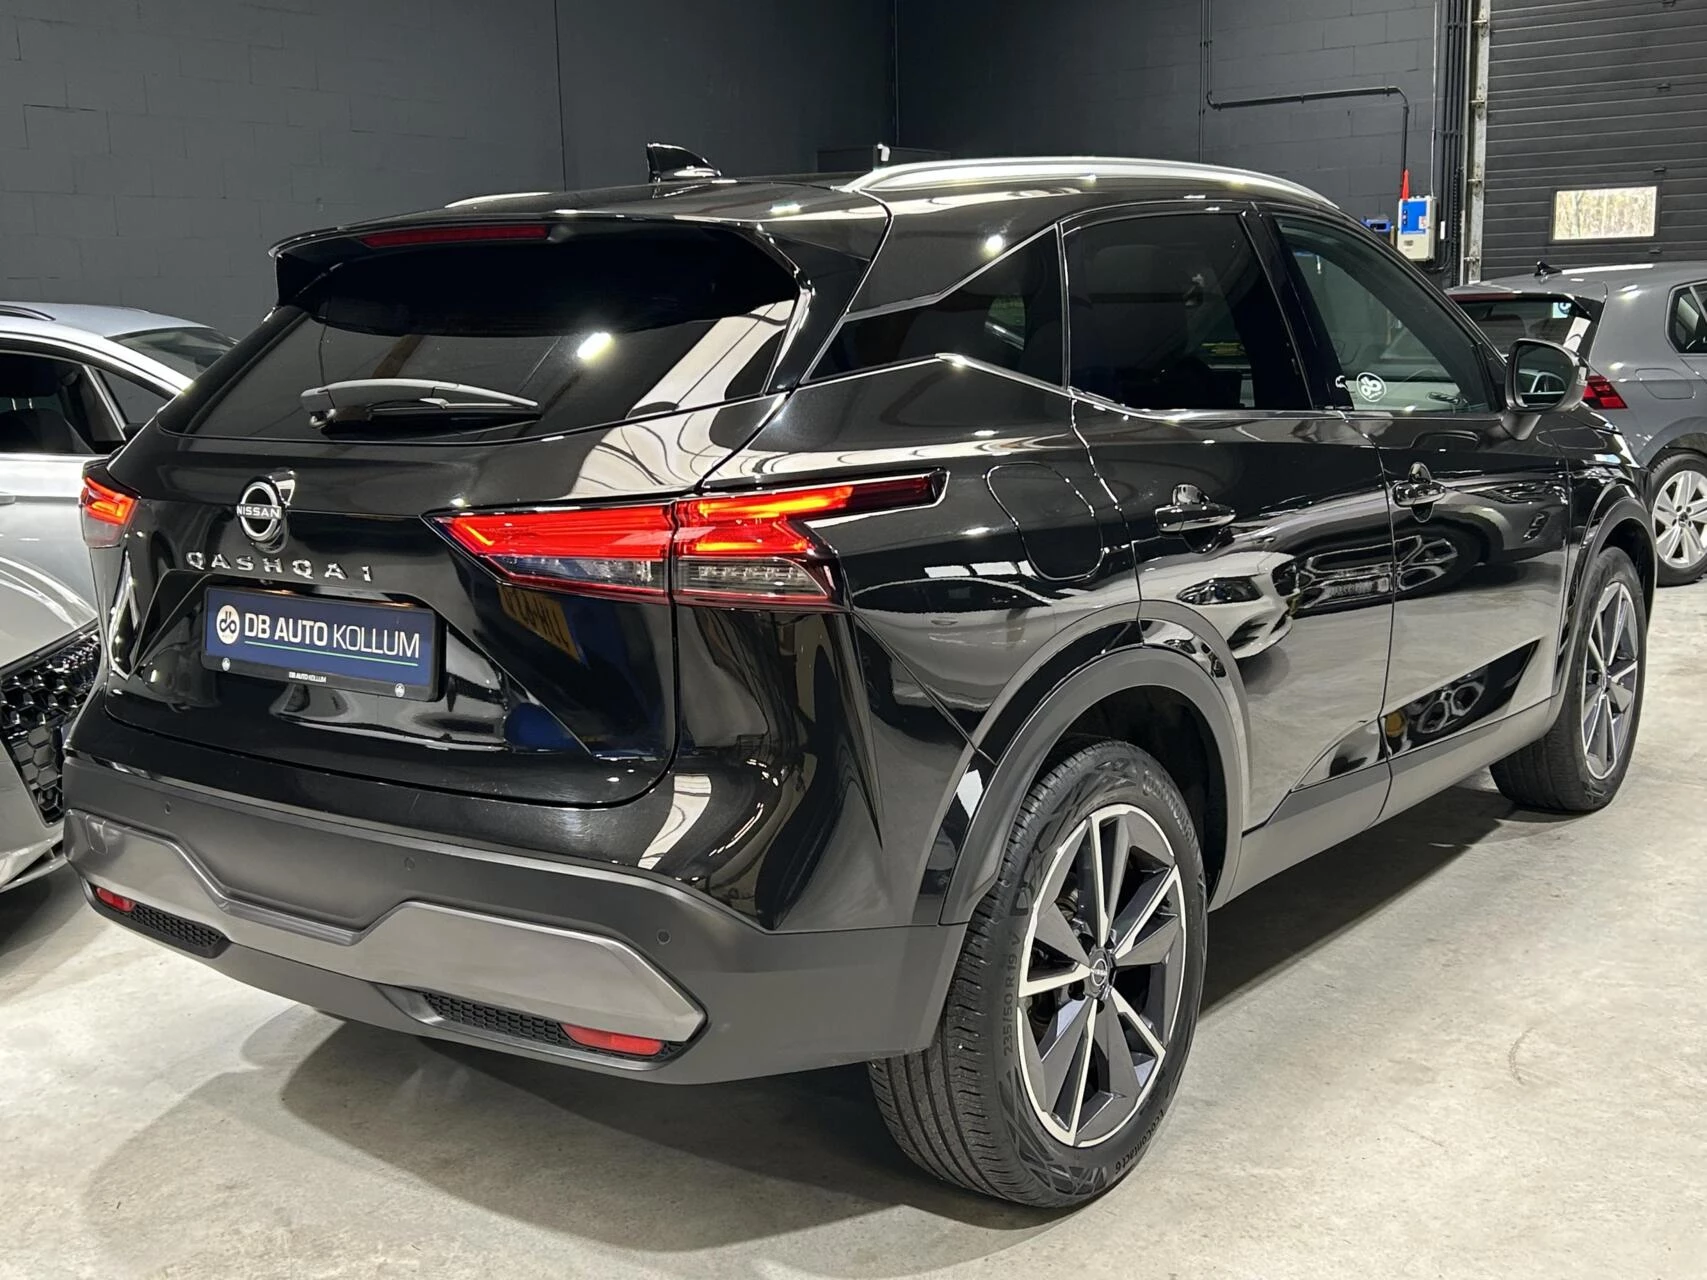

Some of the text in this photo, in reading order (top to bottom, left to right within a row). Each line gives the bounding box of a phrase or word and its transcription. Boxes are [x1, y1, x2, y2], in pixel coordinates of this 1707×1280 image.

[236, 504, 281, 519] NISSAN
[185, 551, 372, 582] QASHQAI
[244, 612, 420, 659] DB AUTO KOLLUM
[1007, 954, 1018, 971] 19
[1005, 976, 1016, 988] R
[1003, 993, 1014, 1057] 235/50
